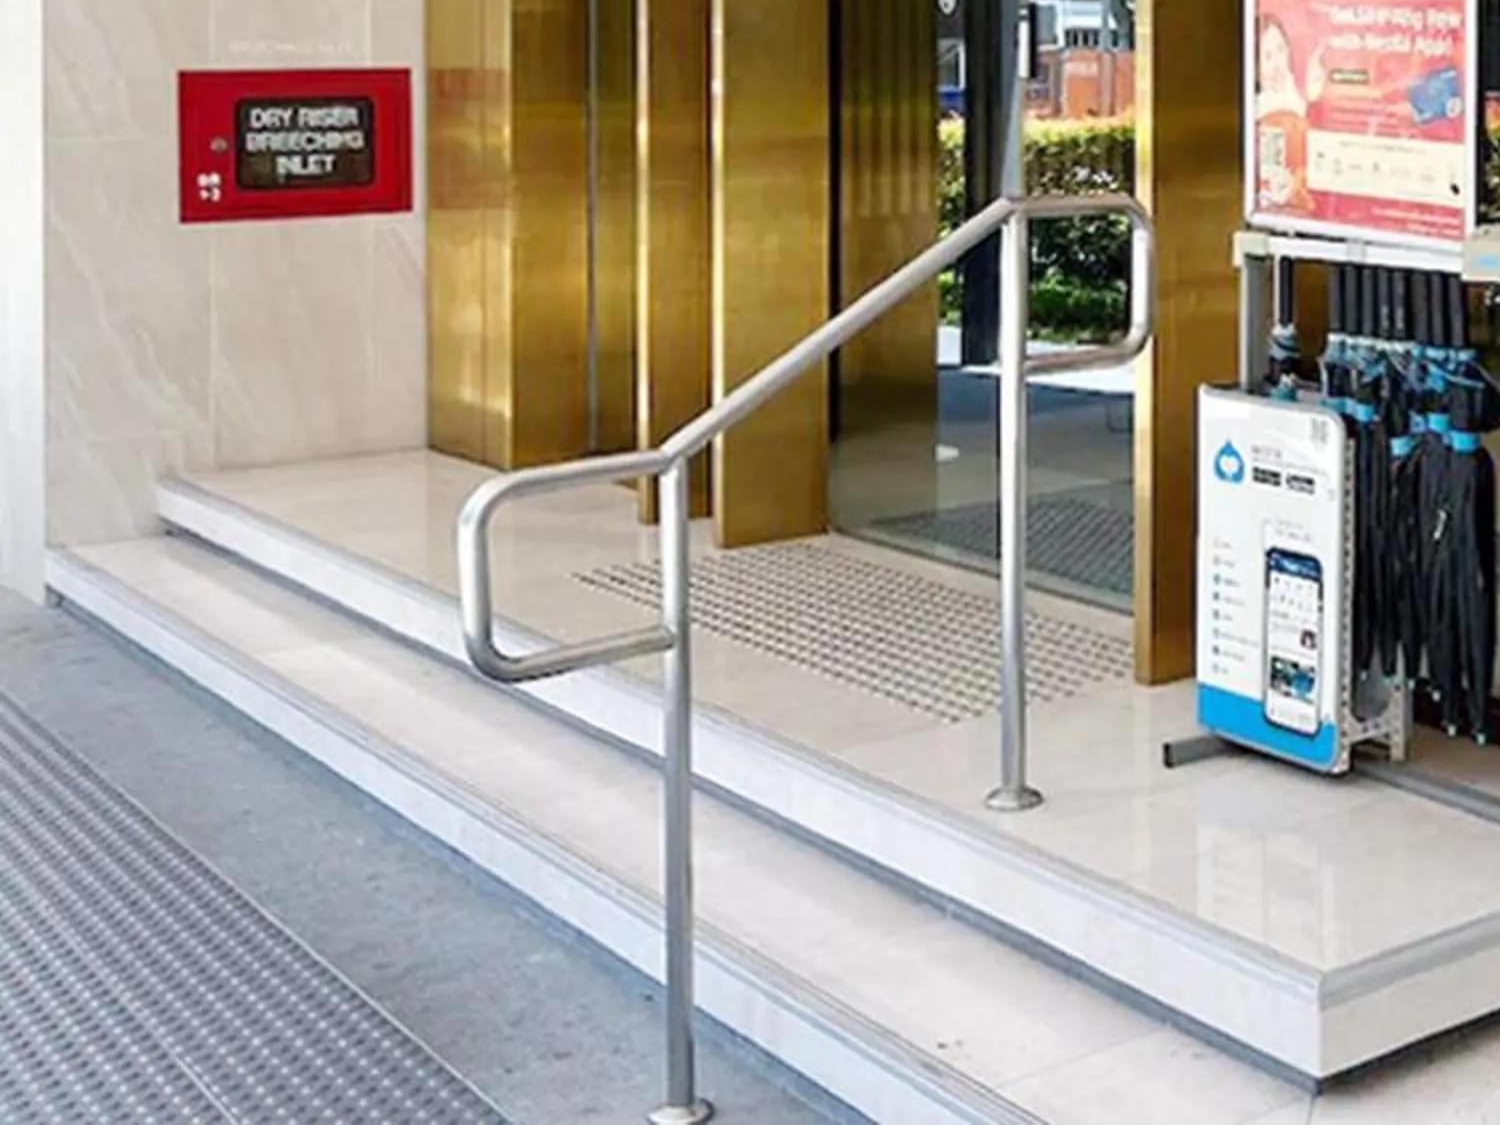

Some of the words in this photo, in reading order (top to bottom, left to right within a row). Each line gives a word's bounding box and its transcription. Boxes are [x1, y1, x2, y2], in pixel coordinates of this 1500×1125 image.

[249, 107, 292, 129] DRY
[297, 105, 359, 128] RISER
[275, 154, 337, 177] INLET
